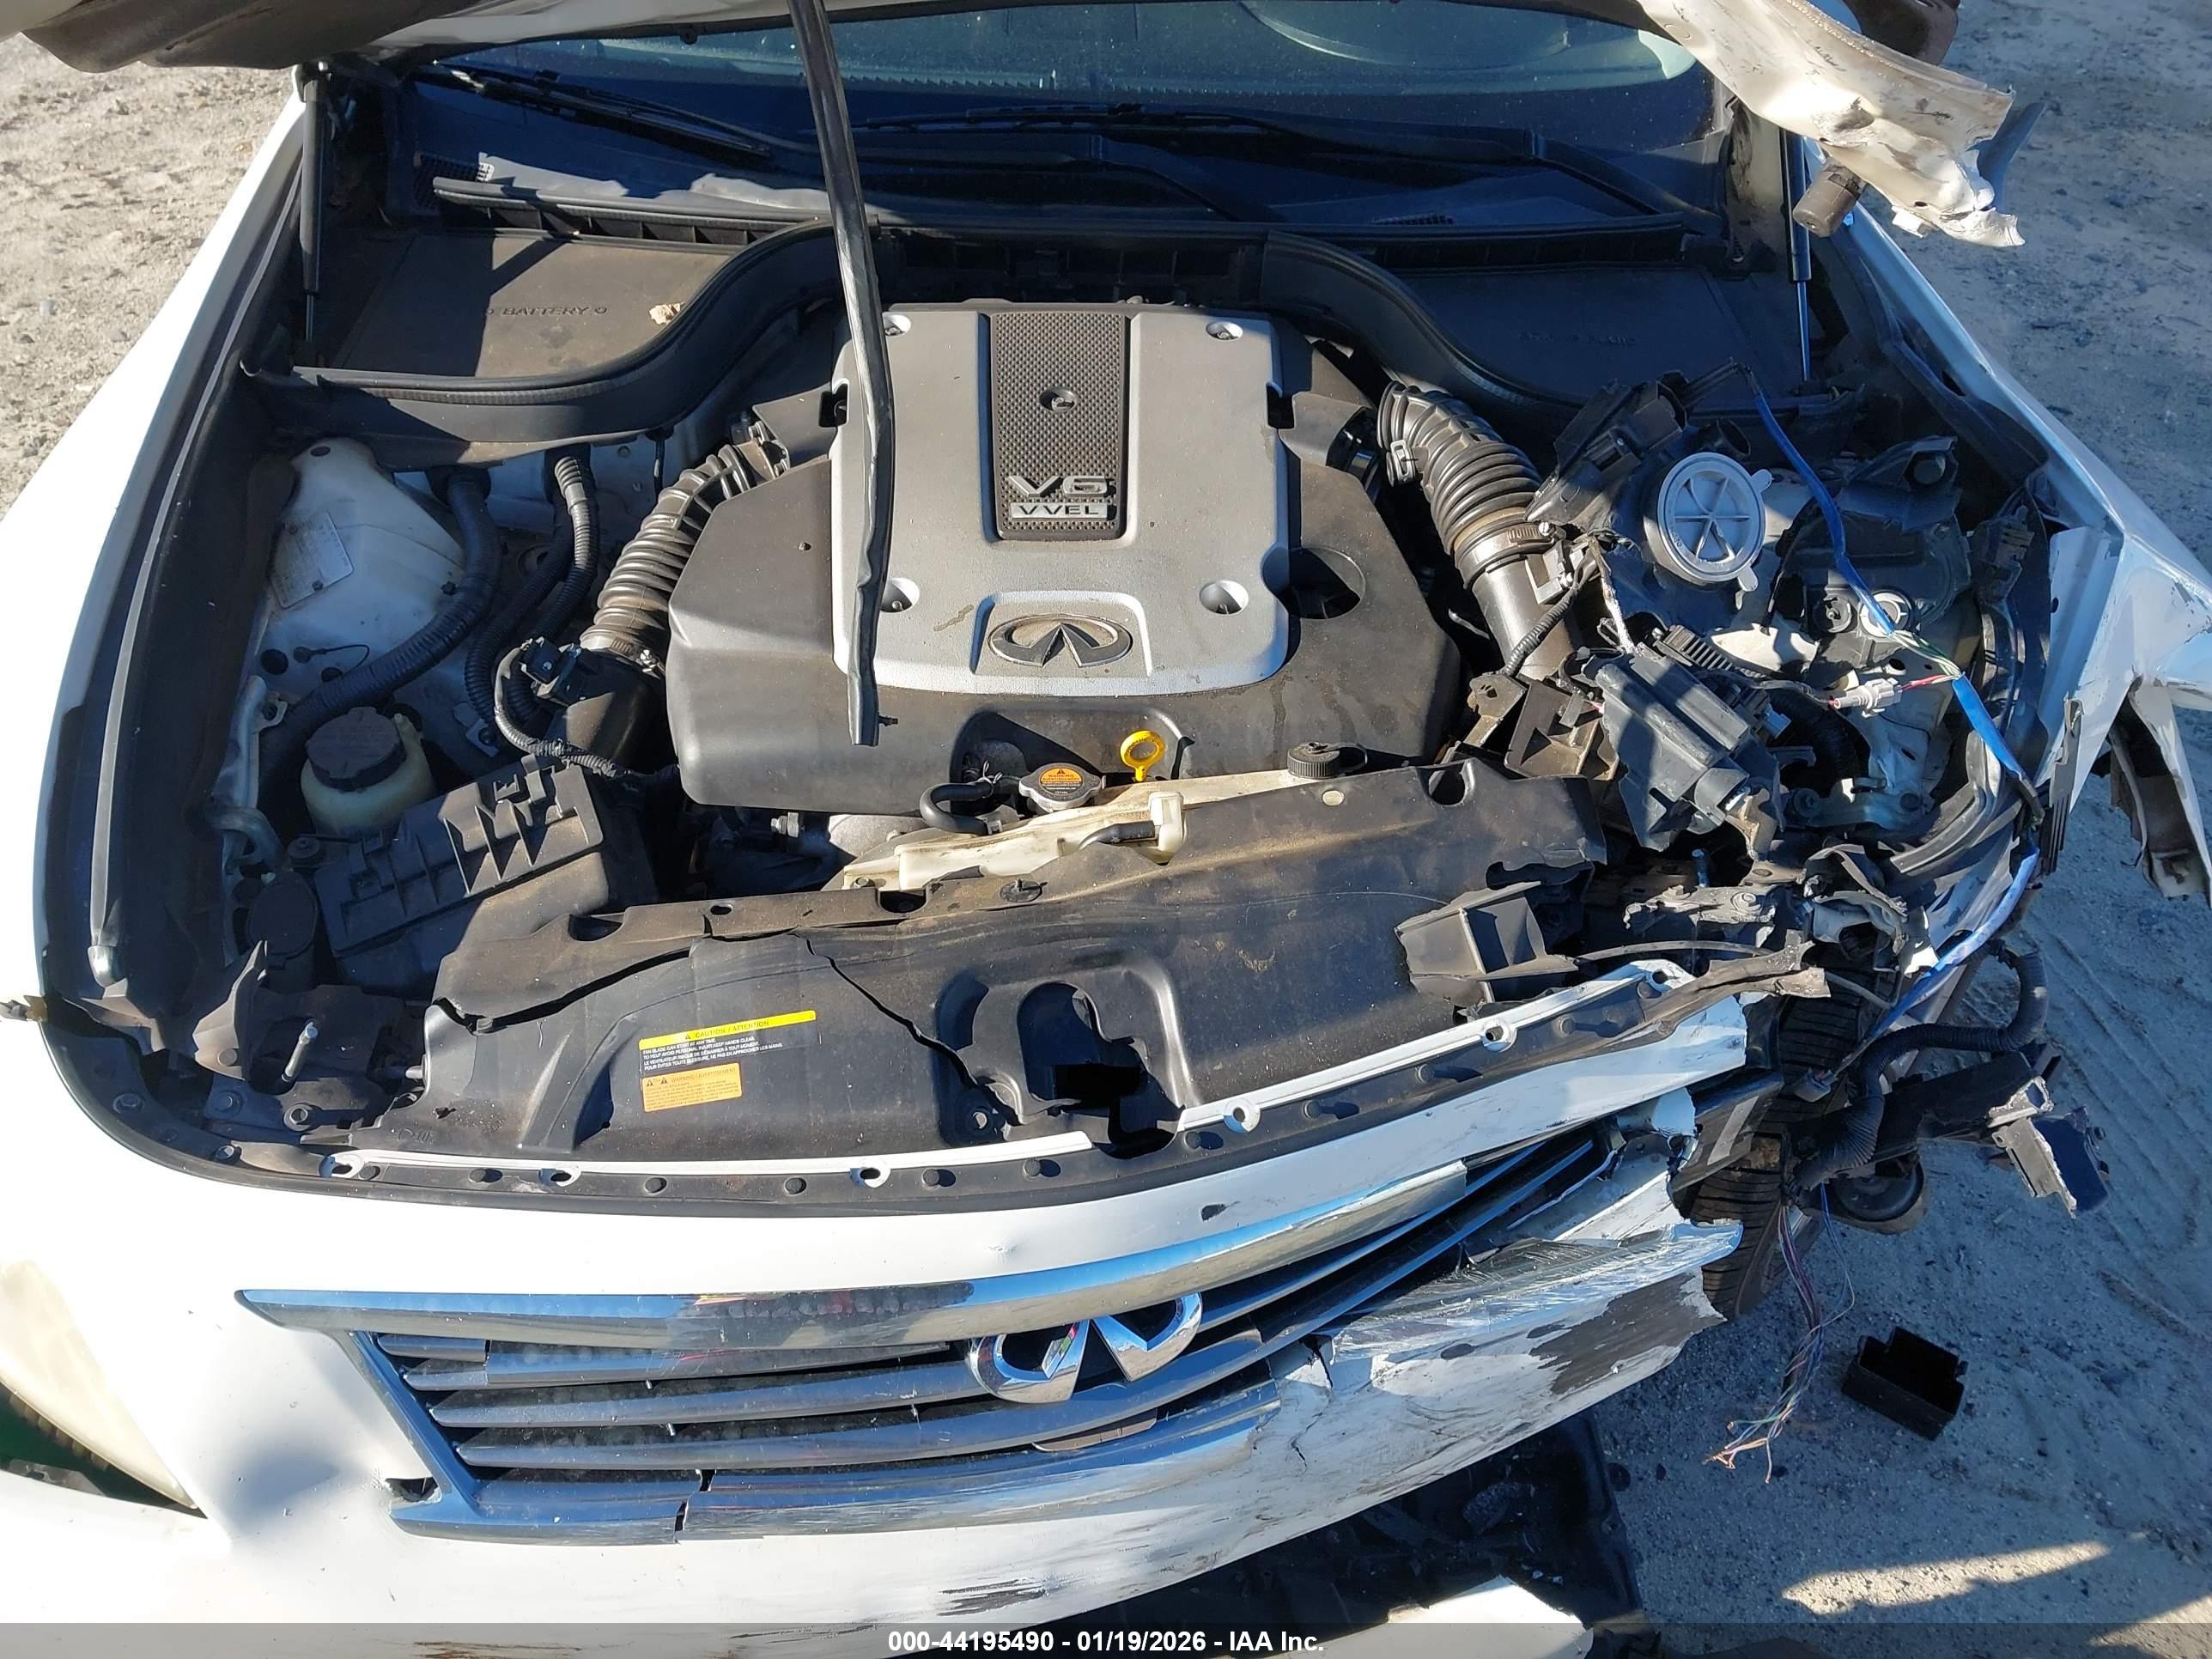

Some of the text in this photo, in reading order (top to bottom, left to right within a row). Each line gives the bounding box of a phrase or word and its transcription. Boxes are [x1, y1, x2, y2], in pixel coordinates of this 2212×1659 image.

[502, 307, 590, 316] BATTERY
[1008, 475, 1108, 498] V6
[1018, 505, 1099, 515] VVEL
[695, 1028, 725, 1037] CAUTION
[732, 1020, 769, 1030] ATTENTION
